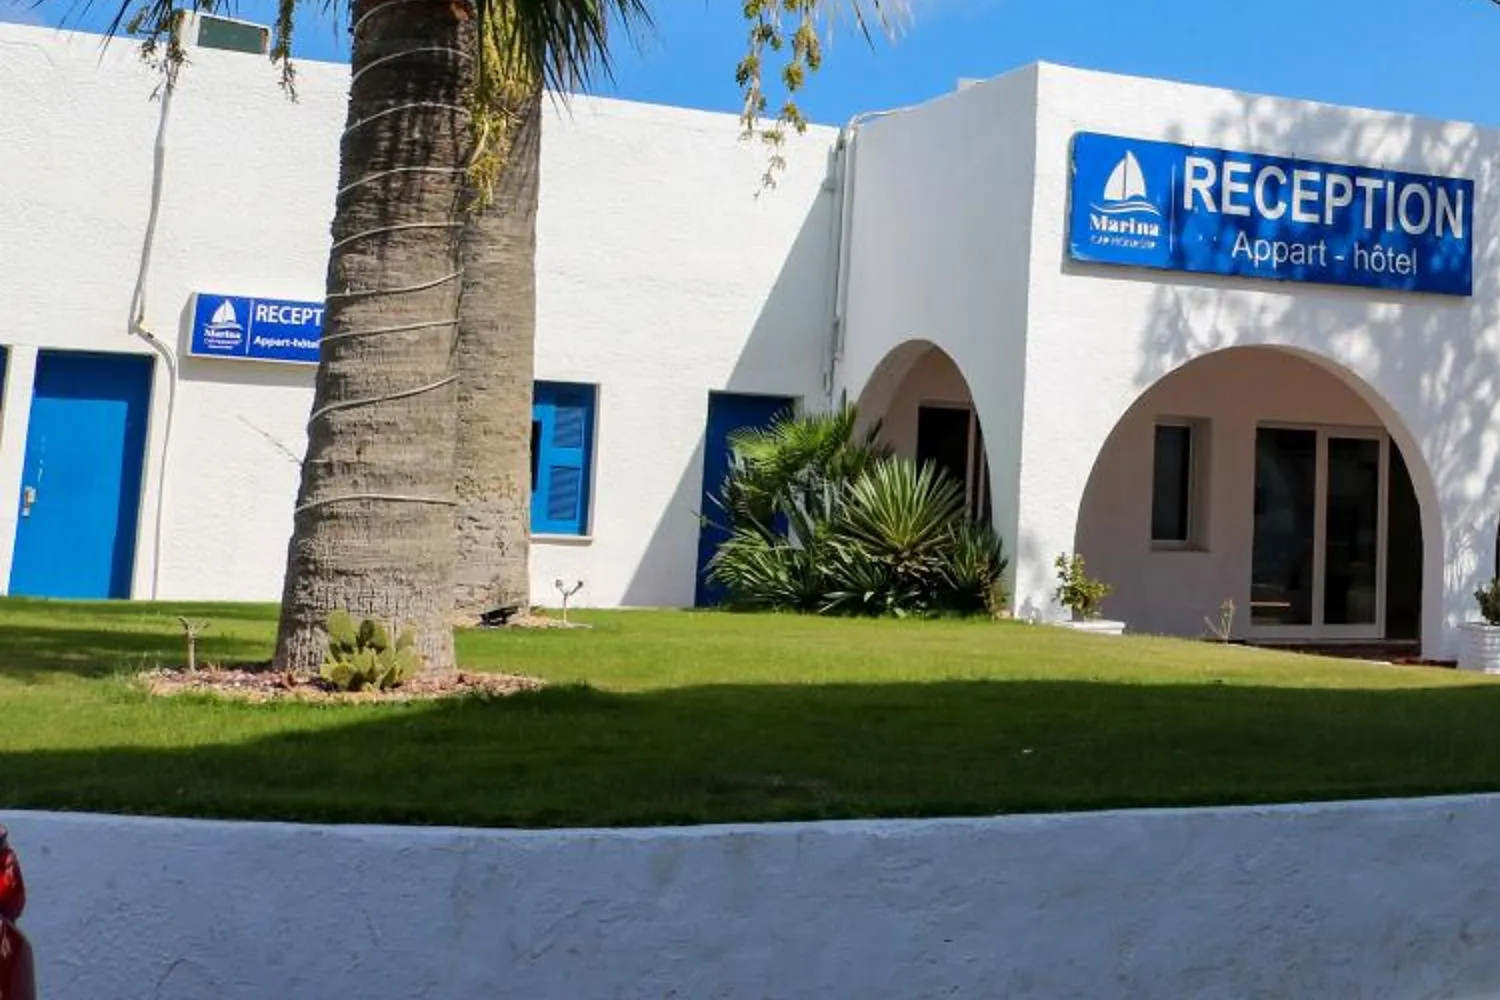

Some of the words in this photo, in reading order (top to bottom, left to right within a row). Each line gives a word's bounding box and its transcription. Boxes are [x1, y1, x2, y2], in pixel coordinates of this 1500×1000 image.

[1183, 155, 1464, 239] RECEPTION
[1089, 213, 1159, 237] Marina
[1232, 230, 1328, 270] Appart
[1353, 241, 1418, 277] hôtel
[255, 304, 325, 327] RECEPT
